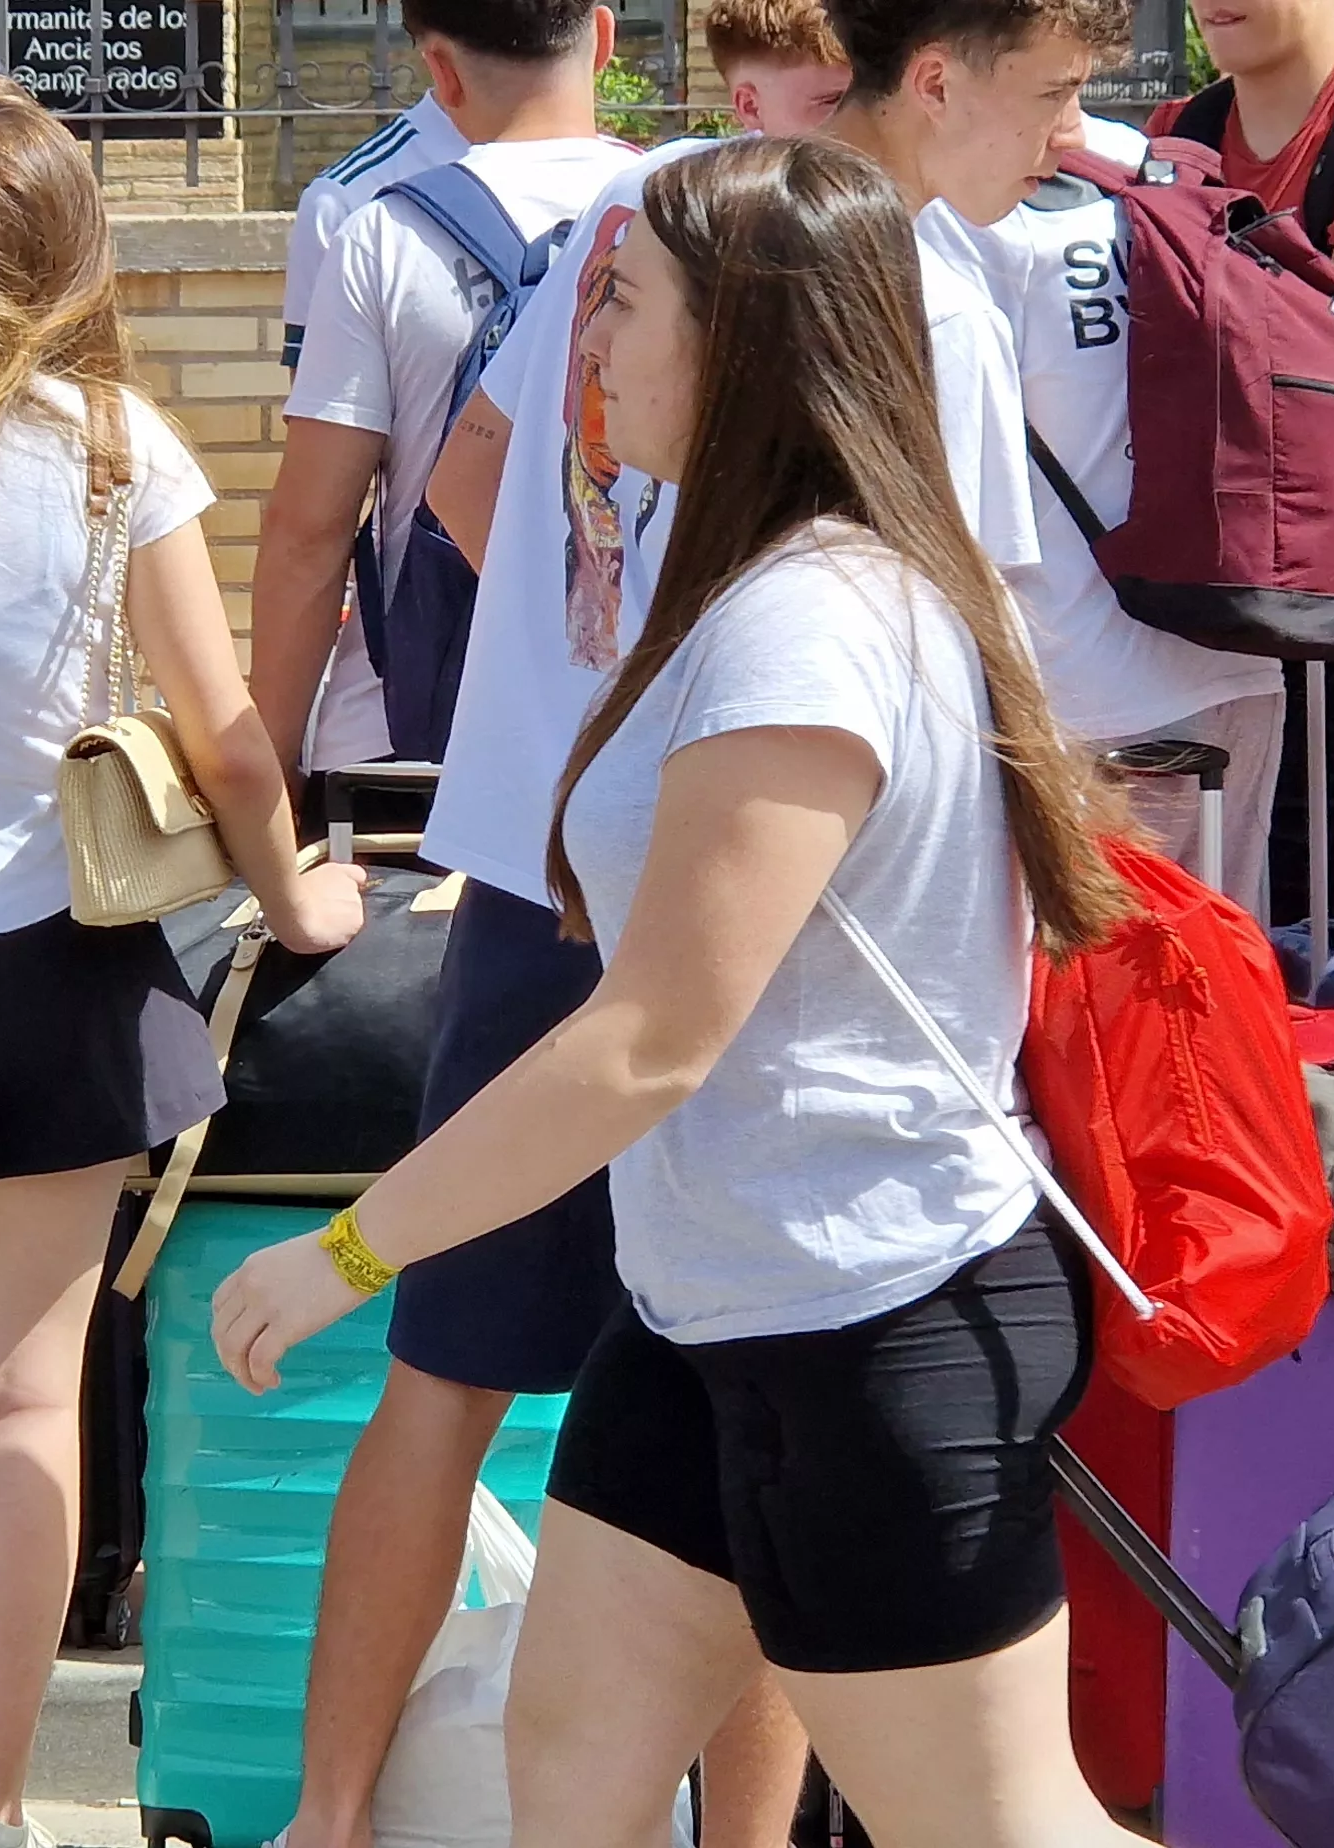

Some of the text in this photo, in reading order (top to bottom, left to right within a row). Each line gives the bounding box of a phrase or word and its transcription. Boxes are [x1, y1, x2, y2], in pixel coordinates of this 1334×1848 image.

[119, 5, 153, 31] de
[159, 4, 187, 30] lo
[24, 36, 143, 61] Ancianos
[14, 65, 178, 97] esamprados
